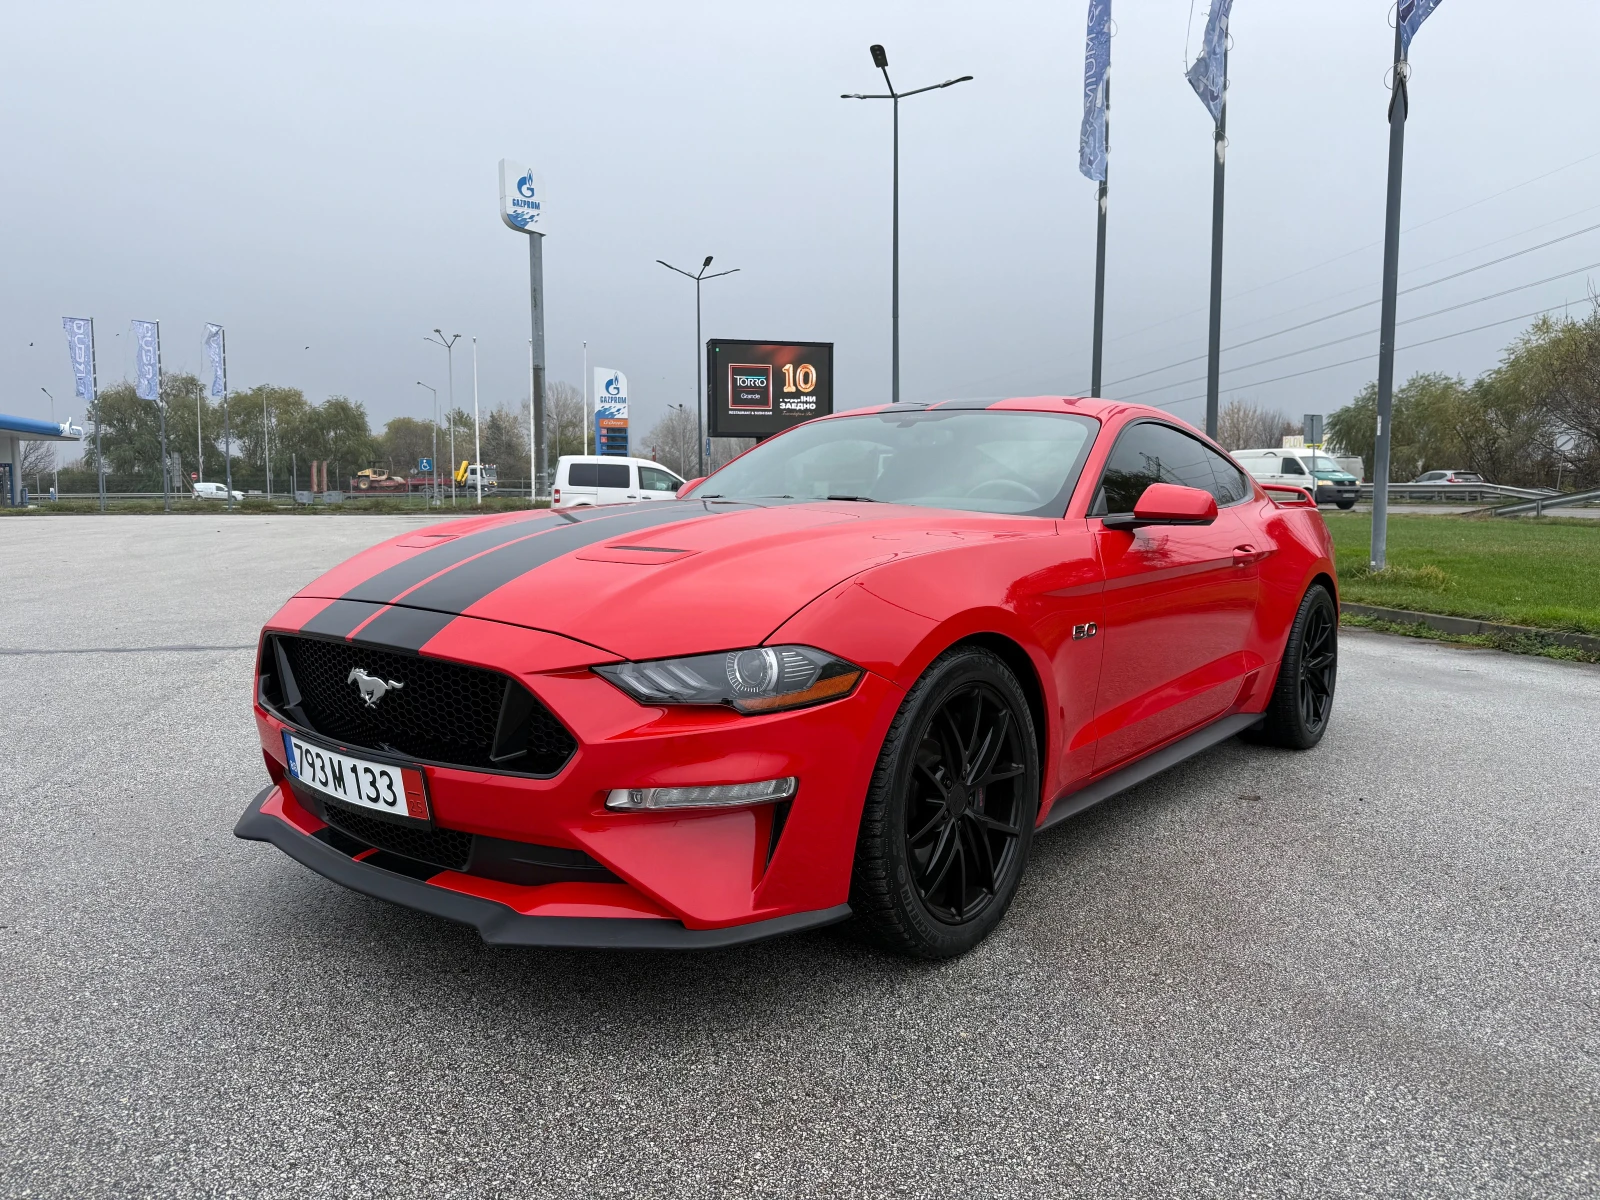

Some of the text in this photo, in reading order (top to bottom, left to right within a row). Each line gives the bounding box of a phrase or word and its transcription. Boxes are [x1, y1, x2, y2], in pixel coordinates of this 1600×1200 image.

[512, 198, 541, 210] GAZPROM
[733, 375, 767, 387] TORRO
[782, 363, 817, 393] 10
[600, 396, 626, 404] GAZPROM
[779, 402, 817, 410] ЗАЕДНО
